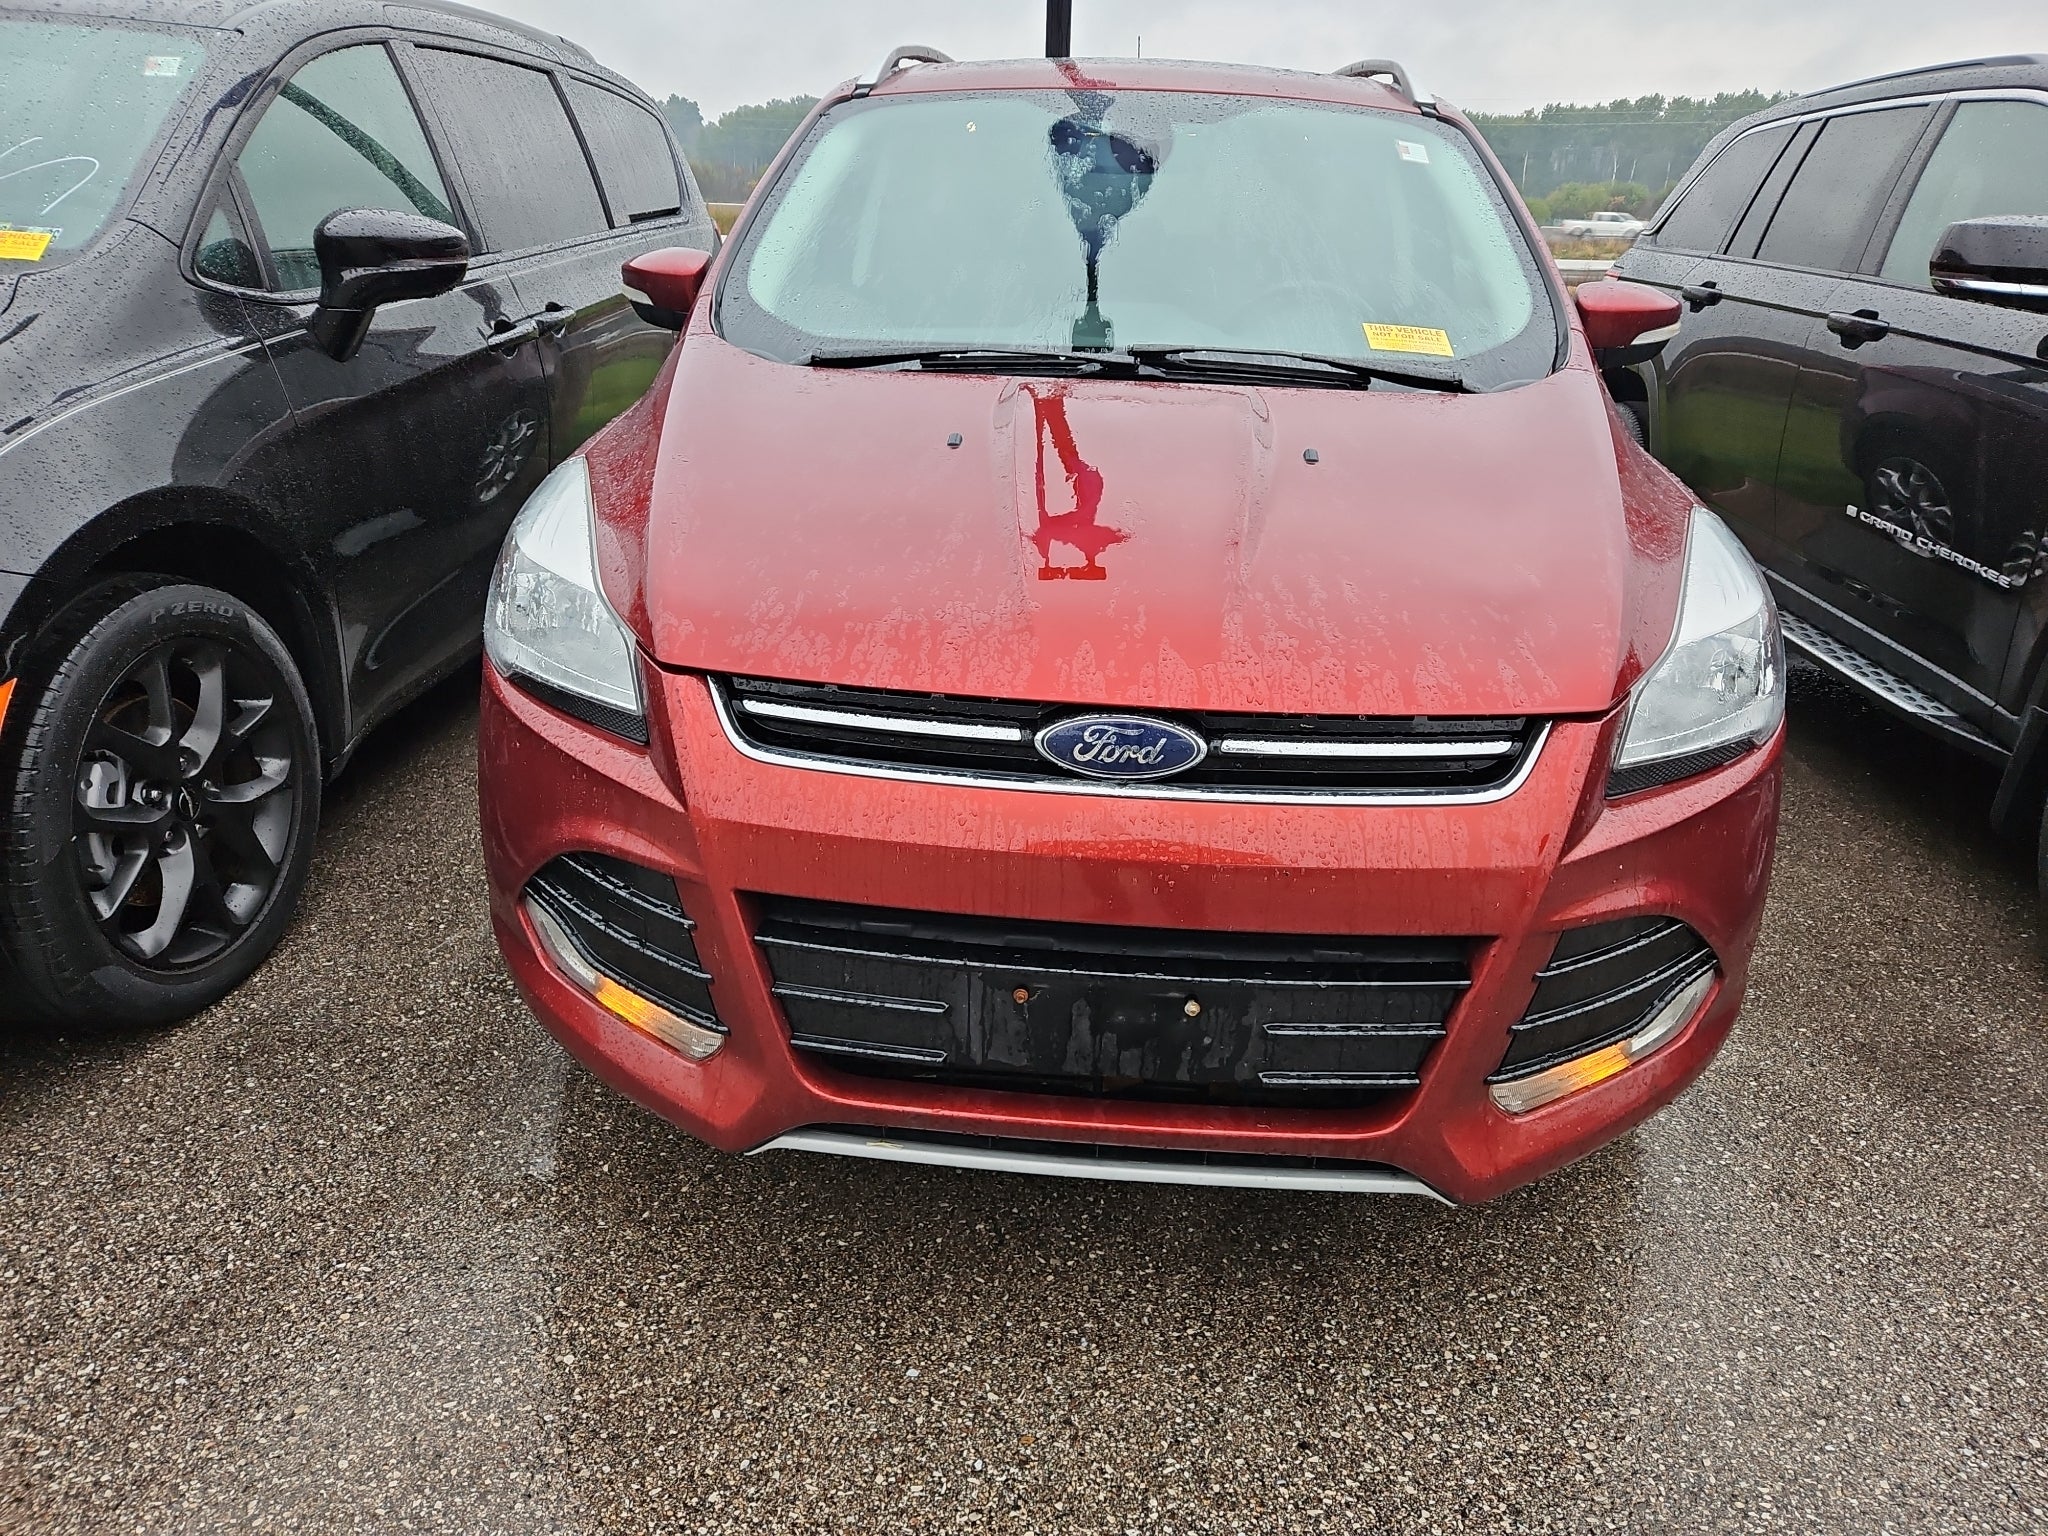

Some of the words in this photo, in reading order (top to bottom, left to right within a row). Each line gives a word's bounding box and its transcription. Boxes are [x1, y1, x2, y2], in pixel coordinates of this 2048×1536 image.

[0, 232, 48, 241] EHICLE
[1367, 324, 1393, 332] THIS
[1395, 326, 1442, 338] VEHICLE
[1417, 335, 1442, 343] SALE
[1859, 511, 1914, 542] GRAND
[1916, 536, 2012, 589] CHEROKEE
[171, 600, 234, 617] ZERO
[1073, 724, 1165, 765] Ford
